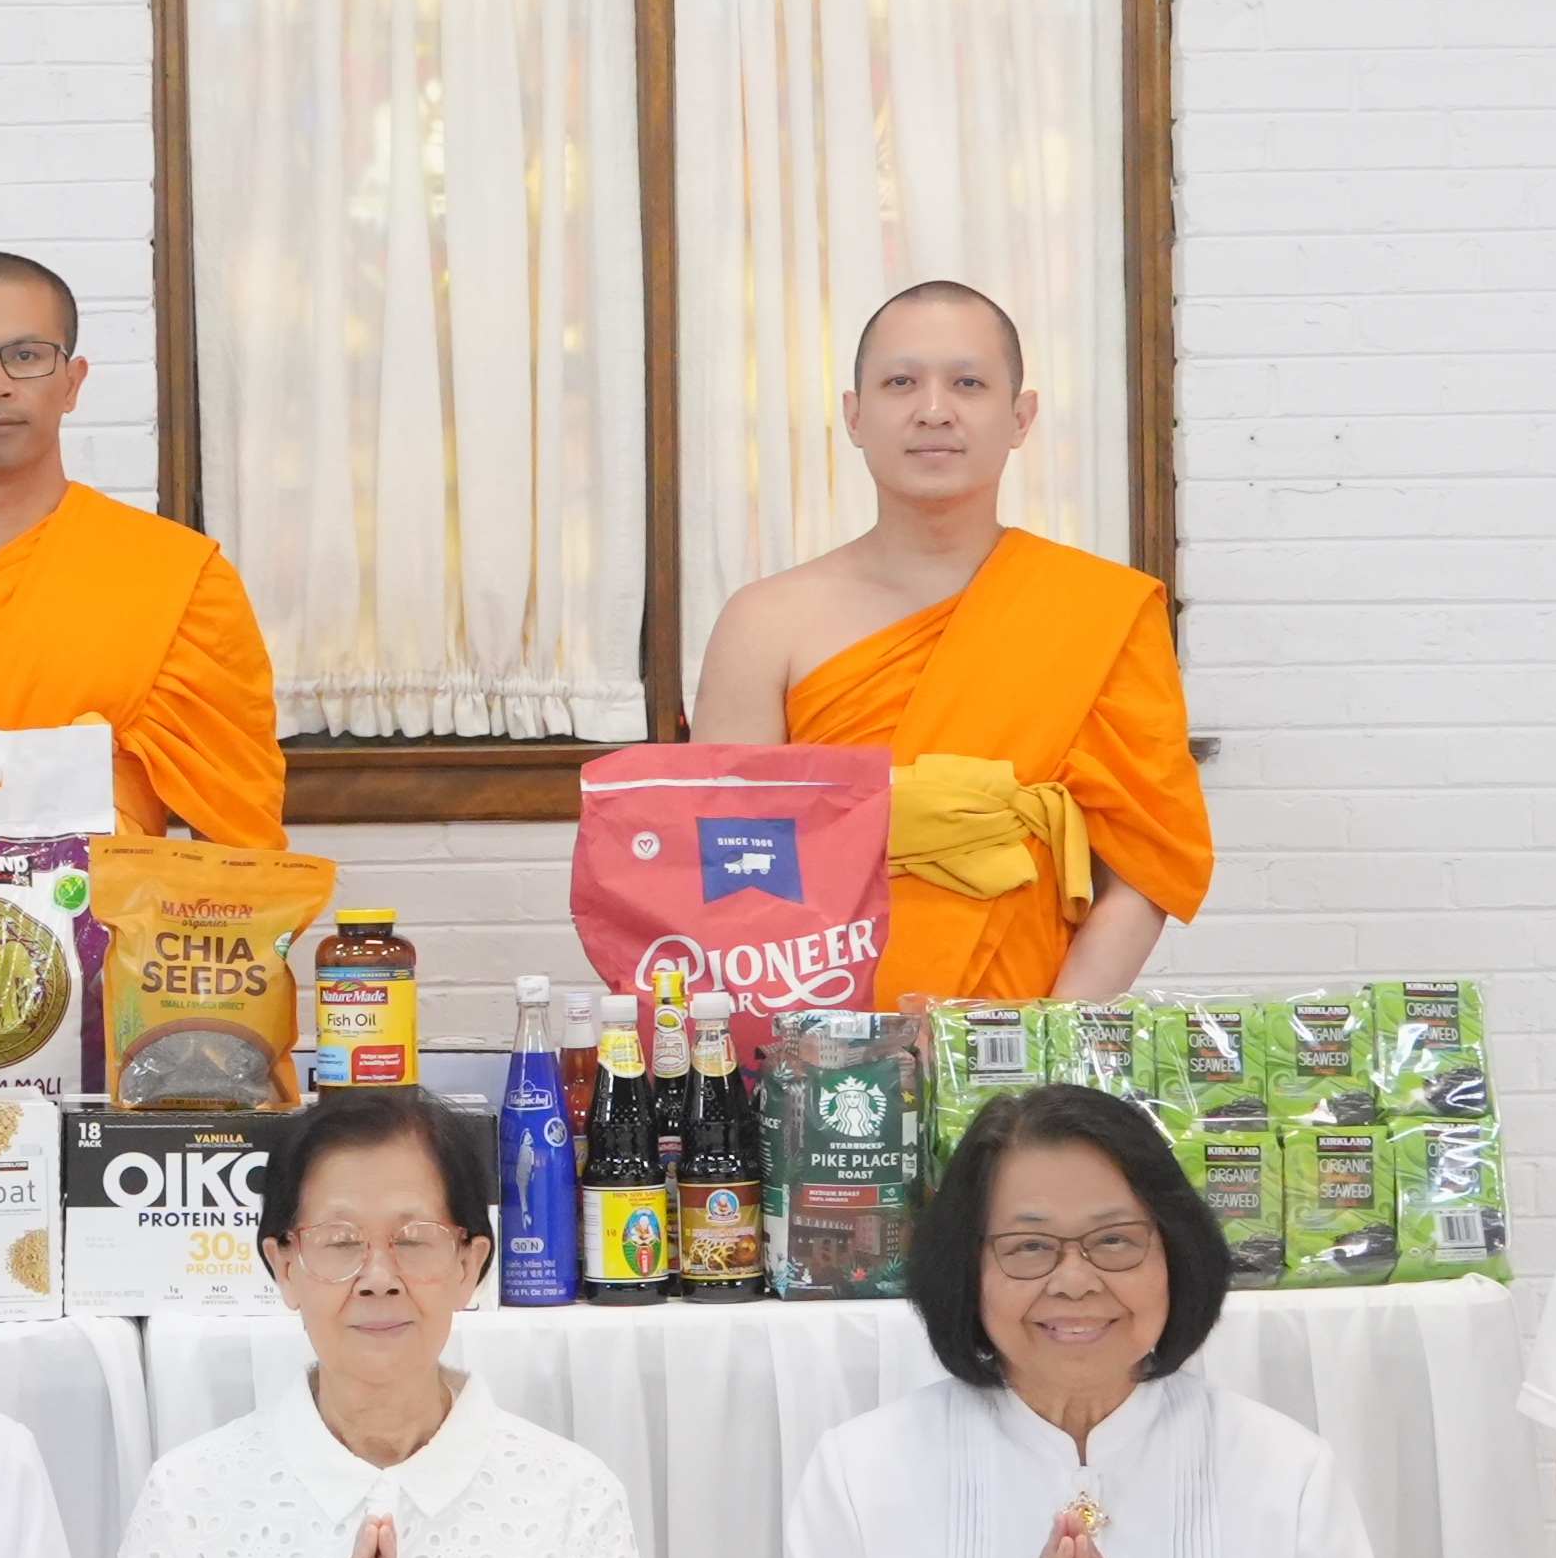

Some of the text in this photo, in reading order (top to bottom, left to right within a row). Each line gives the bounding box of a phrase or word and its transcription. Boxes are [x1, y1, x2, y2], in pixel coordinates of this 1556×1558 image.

[717, 837, 748, 846] SINCE
[161, 900, 253, 920] MAYORGA
[181, 918, 228, 930] organics
[155, 932, 255, 964] CHIA
[141, 960, 267, 996] SEEDS
[1406, 982, 1458, 991] KIRKLAND
[967, 1010, 1019, 1020] KIRKLAND
[1297, 1006, 1349, 1015] KIRKLAND
[1406, 1002, 1458, 1018] ORGANIC
[327, 1013, 377, 1026] Fish Oil
[1298, 1052, 1349, 1066] SEAWEED
[15, 1077, 61, 1094] MALI
[78, 1122, 101, 1140] 18
[78, 1140, 102, 1148] PACK
[194, 1134, 244, 1143] VANILLA
[1319, 1137, 1372, 1146] KIRKLAND
[829, 1142, 883, 1150] STARBUCKS
[1207, 1146, 1260, 1156] KIRKLAND
[811, 1153, 898, 1167] PIKE PLACE
[1319, 1158, 1372, 1174] ORGANIC
[102, 1151, 270, 1208] OIKO
[838, 1170, 874, 1179] ROAST
[1207, 1168, 1259, 1183] ORGANIC
[1320, 1183, 1372, 1198] SEAWEED
[1208, 1193, 1259, 1208] SEAWEED
[138, 1212, 225, 1228] PROTEIN
[189, 1231, 252, 1264] 30g
[514, 1242, 539, 1251] 30 N
[186, 1264, 253, 1275] PROTEIN
[169, 1285, 179, 1294] 1g
[211, 1285, 228, 1293] NO
[263, 1285, 274, 1294] 5g
